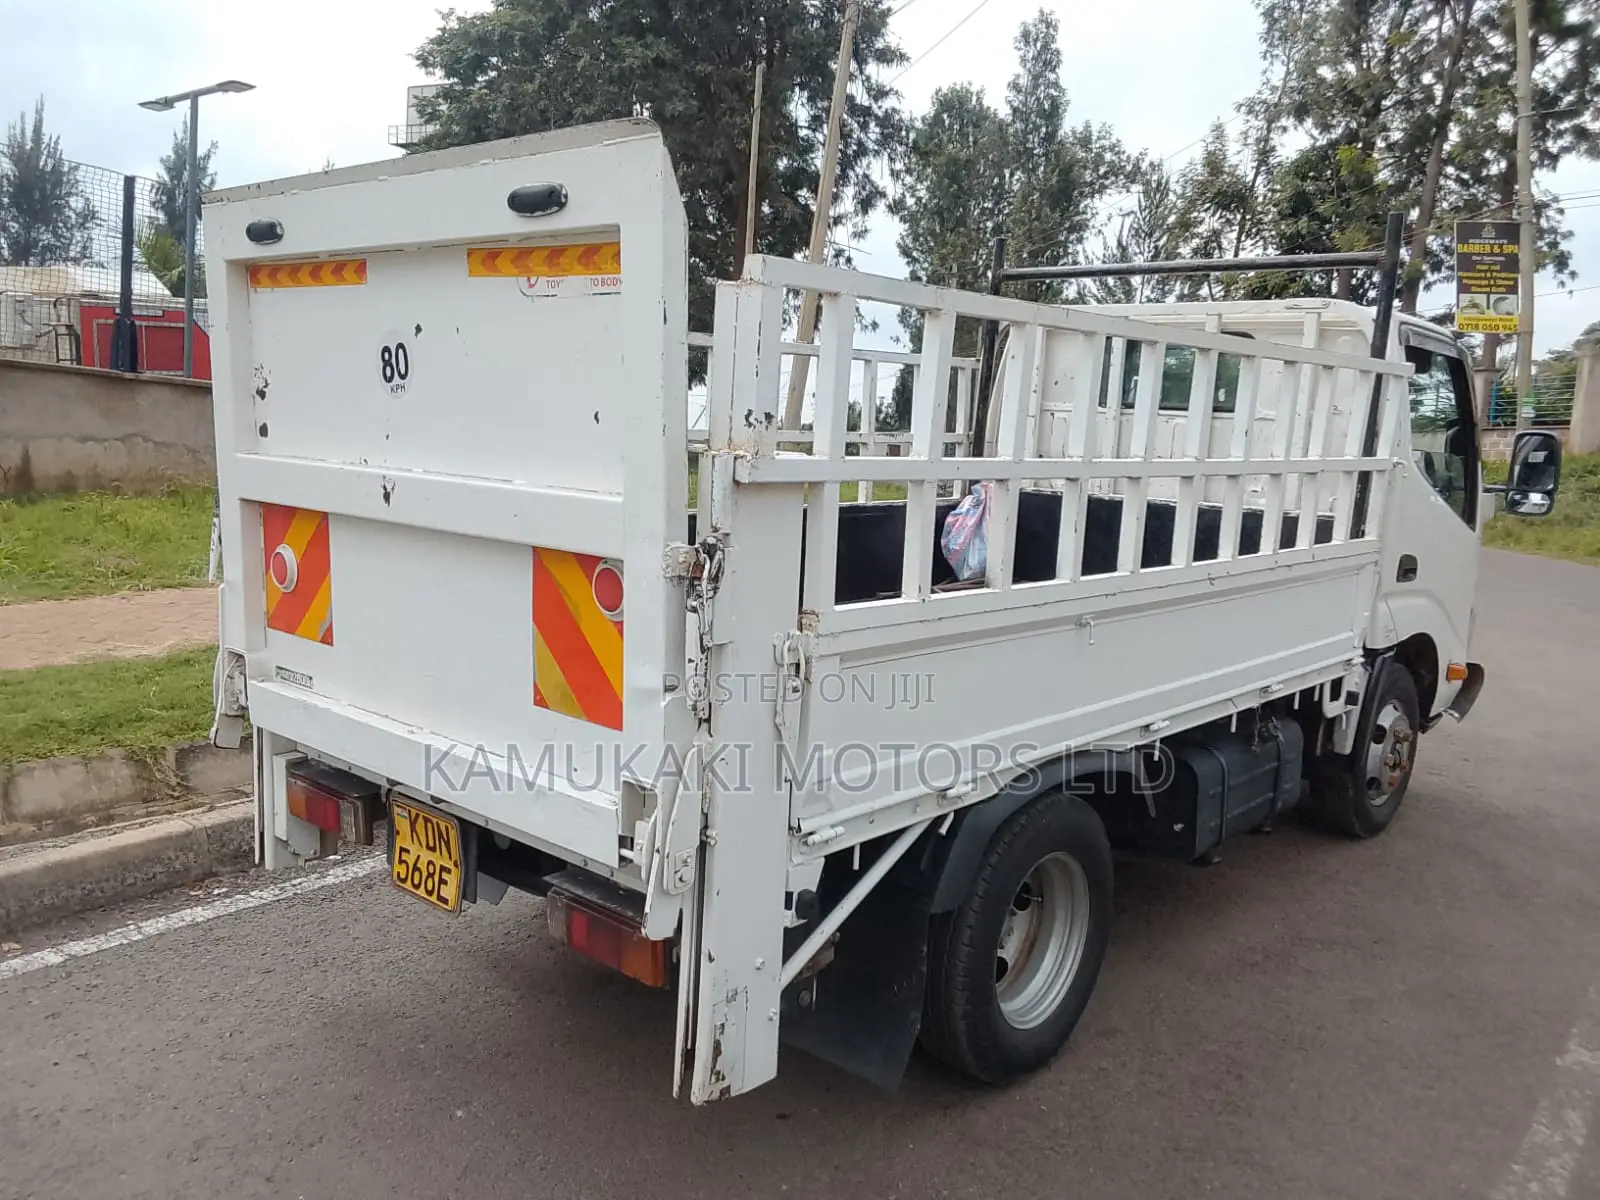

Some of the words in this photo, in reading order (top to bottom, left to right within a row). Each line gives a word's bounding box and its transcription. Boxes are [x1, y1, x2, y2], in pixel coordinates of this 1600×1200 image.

[1457, 244, 1491, 253] BARBER
[1493, 244, 1501, 253] &
[1503, 245, 1519, 253] SPA
[1481, 323, 1500, 331] 050
[381, 342, 409, 384] 80
[390, 383, 406, 394] KPH
[407, 808, 453, 861] KDN
[396, 845, 452, 906] 568E
